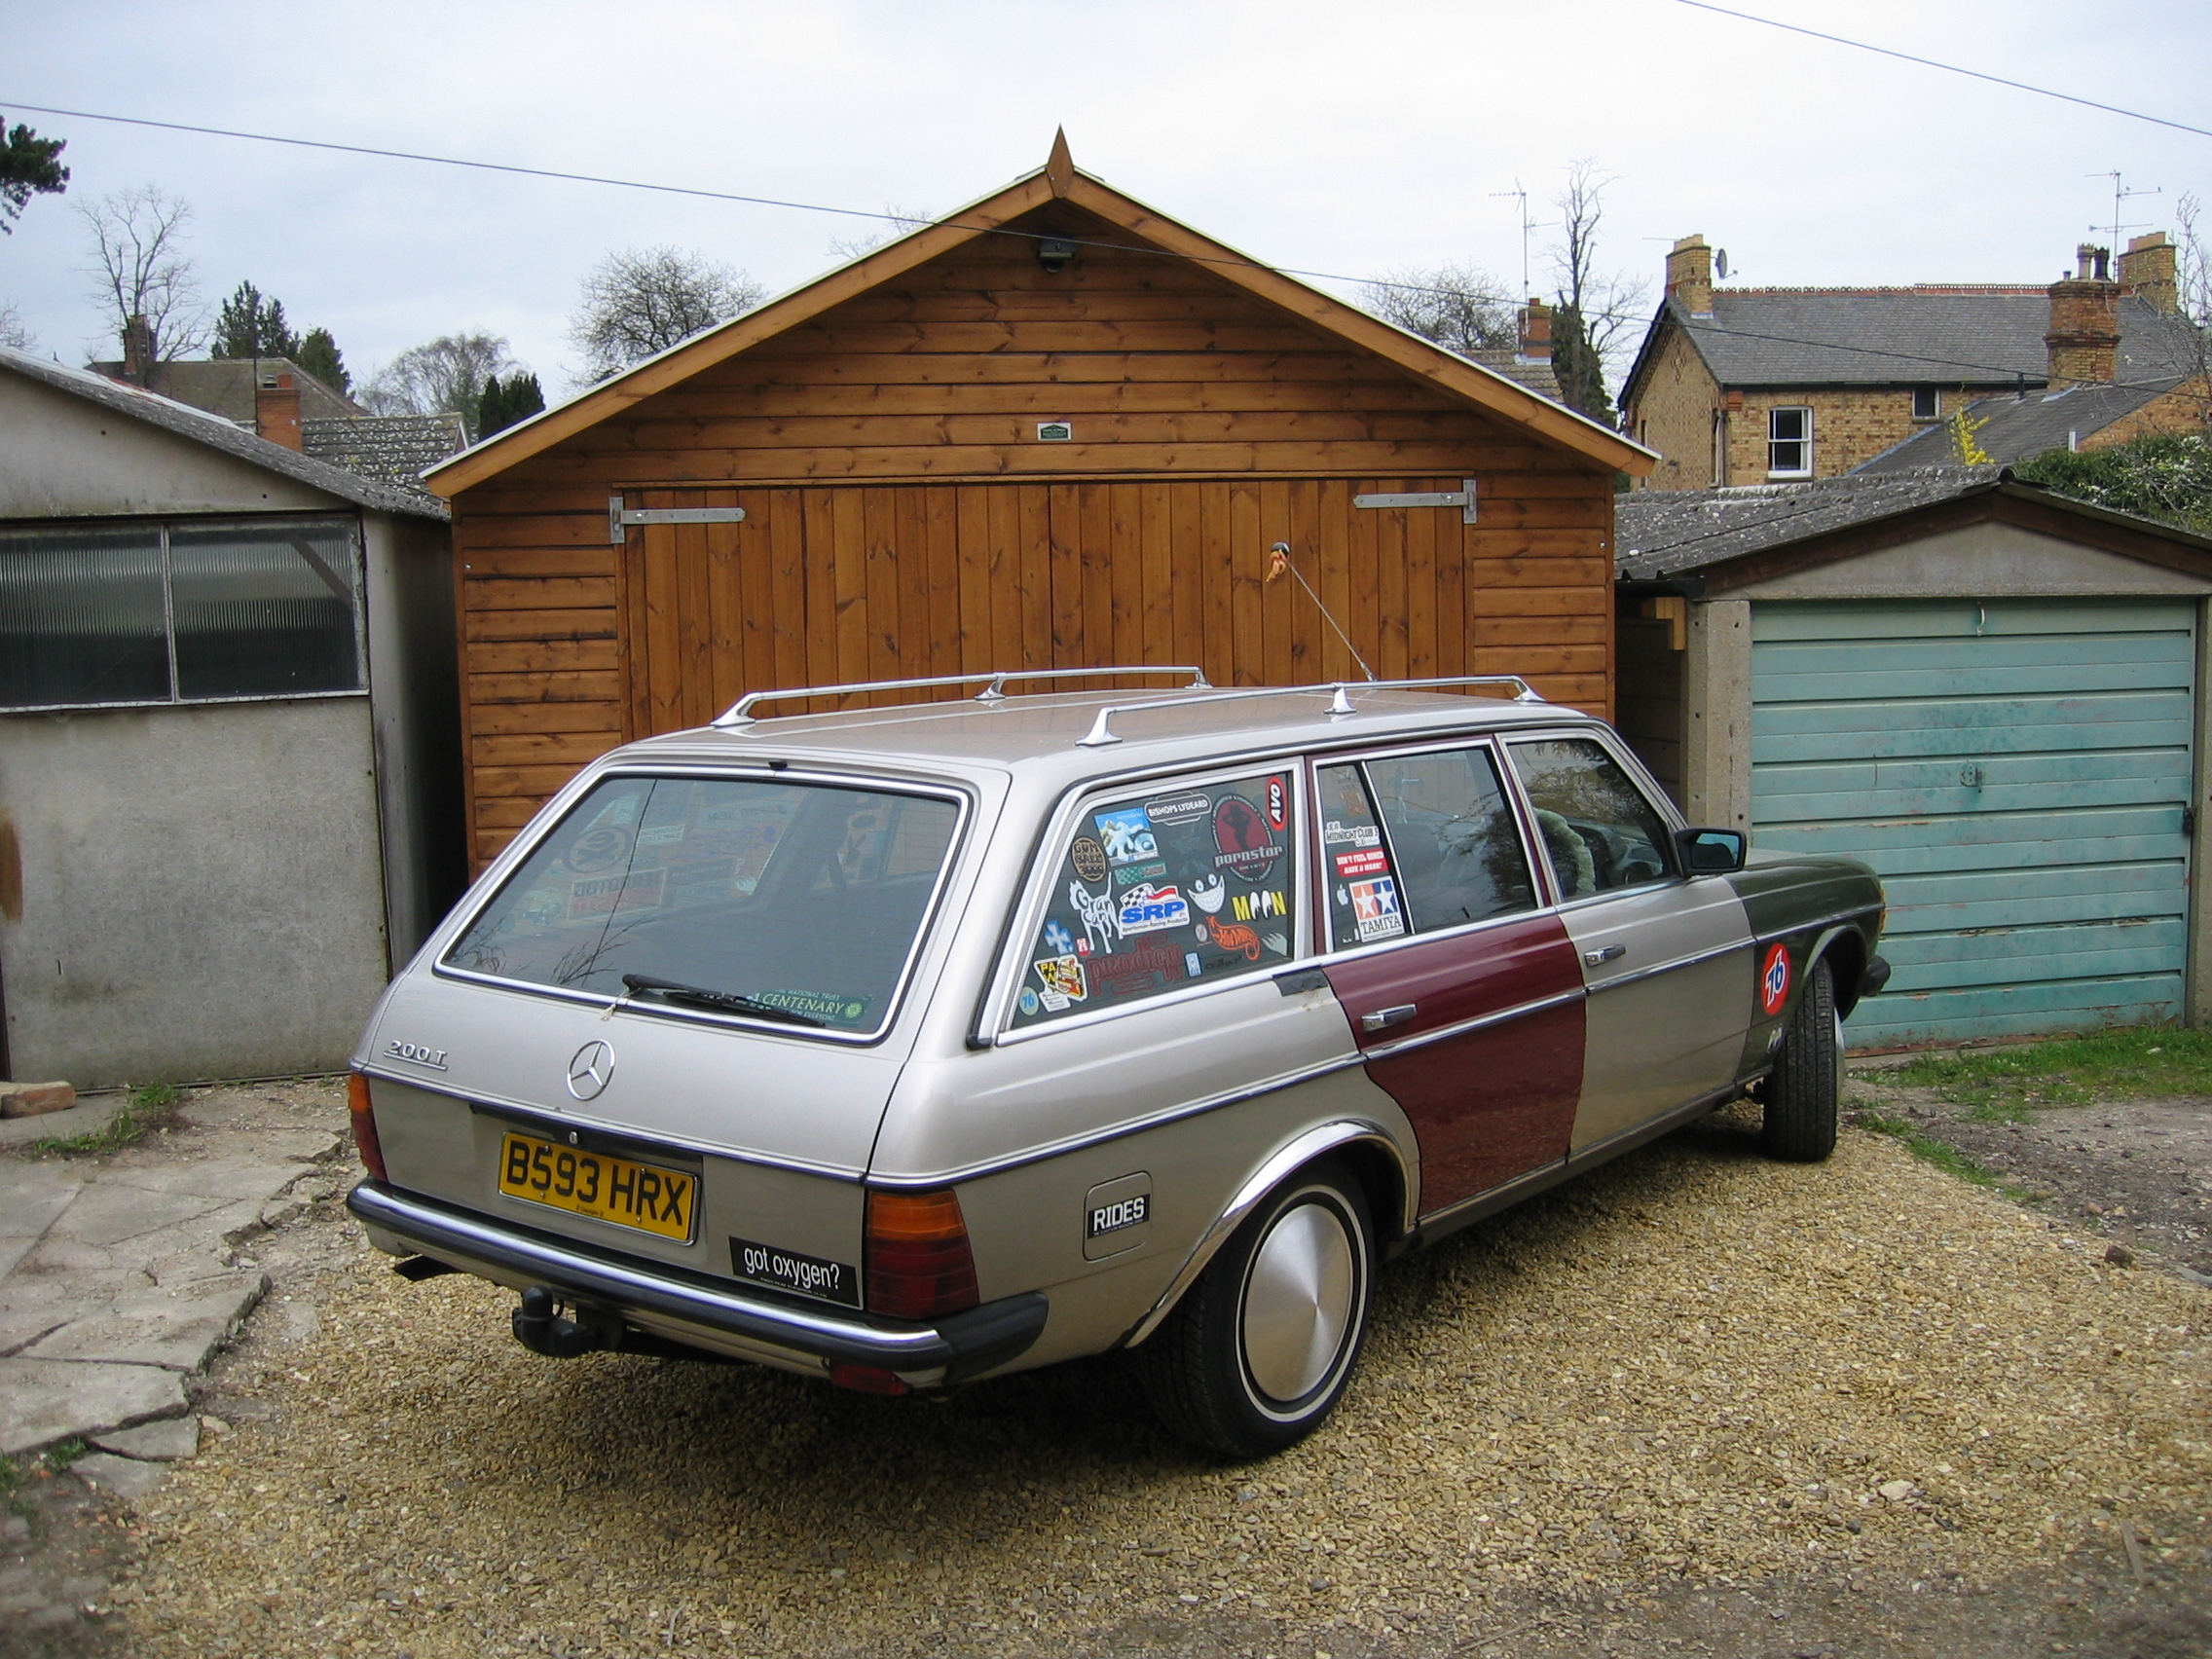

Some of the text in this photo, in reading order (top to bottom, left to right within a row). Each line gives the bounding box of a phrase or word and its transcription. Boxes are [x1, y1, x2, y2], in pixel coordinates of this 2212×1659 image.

[1148, 804, 1179, 817] BISHOPS
[1177, 799, 1208, 812] LYDEARD
[1270, 784, 1282, 824] AVO
[1214, 845, 1283, 868] pornstar
[1076, 889, 1114, 913] Gran
[1122, 901, 1185, 924] SRP
[1360, 915, 1401, 934] TAMIYA
[1765, 948, 1786, 1008] 76
[762, 993, 844, 1014] CENTENARY
[1022, 992, 1035, 1009] 76
[506, 1139, 687, 1227] B593 HRX
[1093, 1197, 1145, 1232] RIDES
[744, 1247, 770, 1274] got
[772, 1255, 840, 1290] oxygen?
